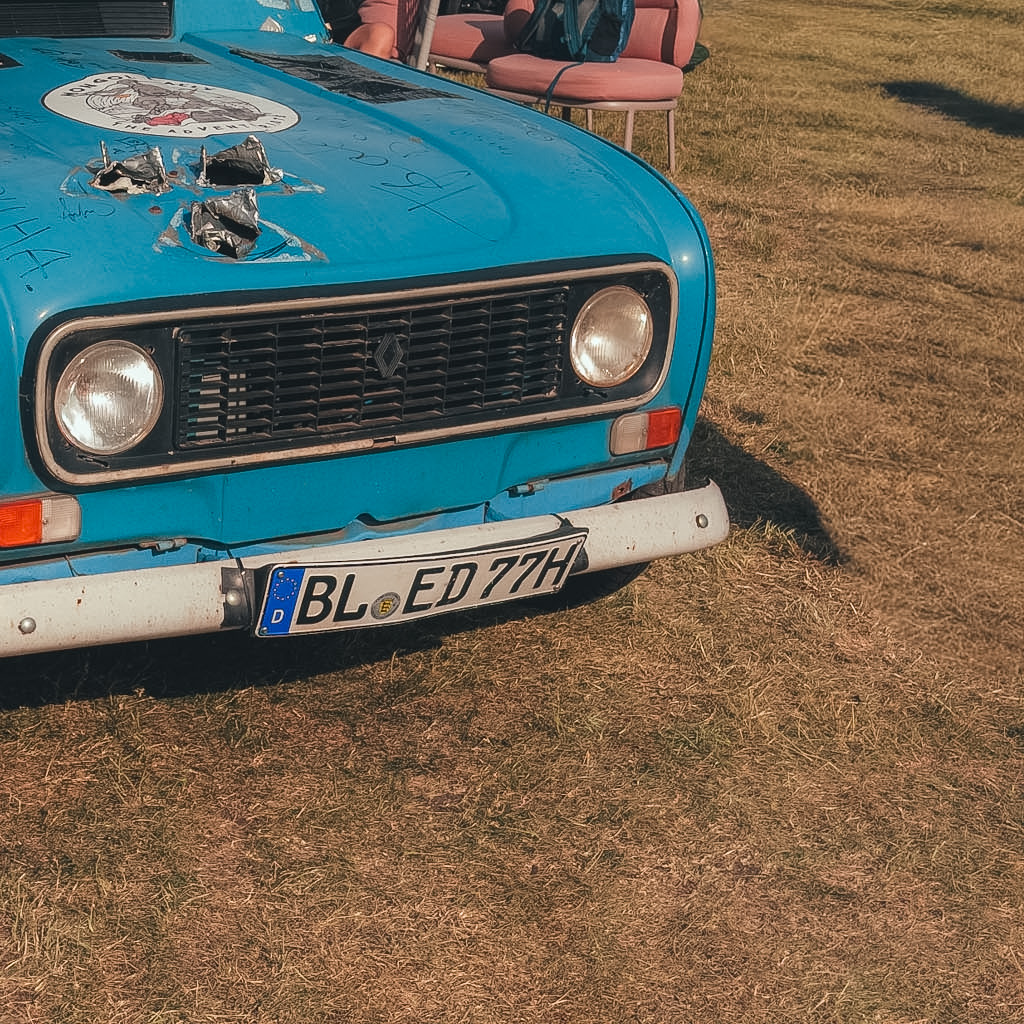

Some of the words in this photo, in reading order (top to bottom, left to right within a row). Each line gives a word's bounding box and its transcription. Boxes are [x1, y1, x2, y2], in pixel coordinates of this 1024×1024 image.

[296, 573, 368, 625] BL
[402, 562, 478, 614] ED
[480, 542, 578, 599] 77H
[271, 609, 284, 624] D
